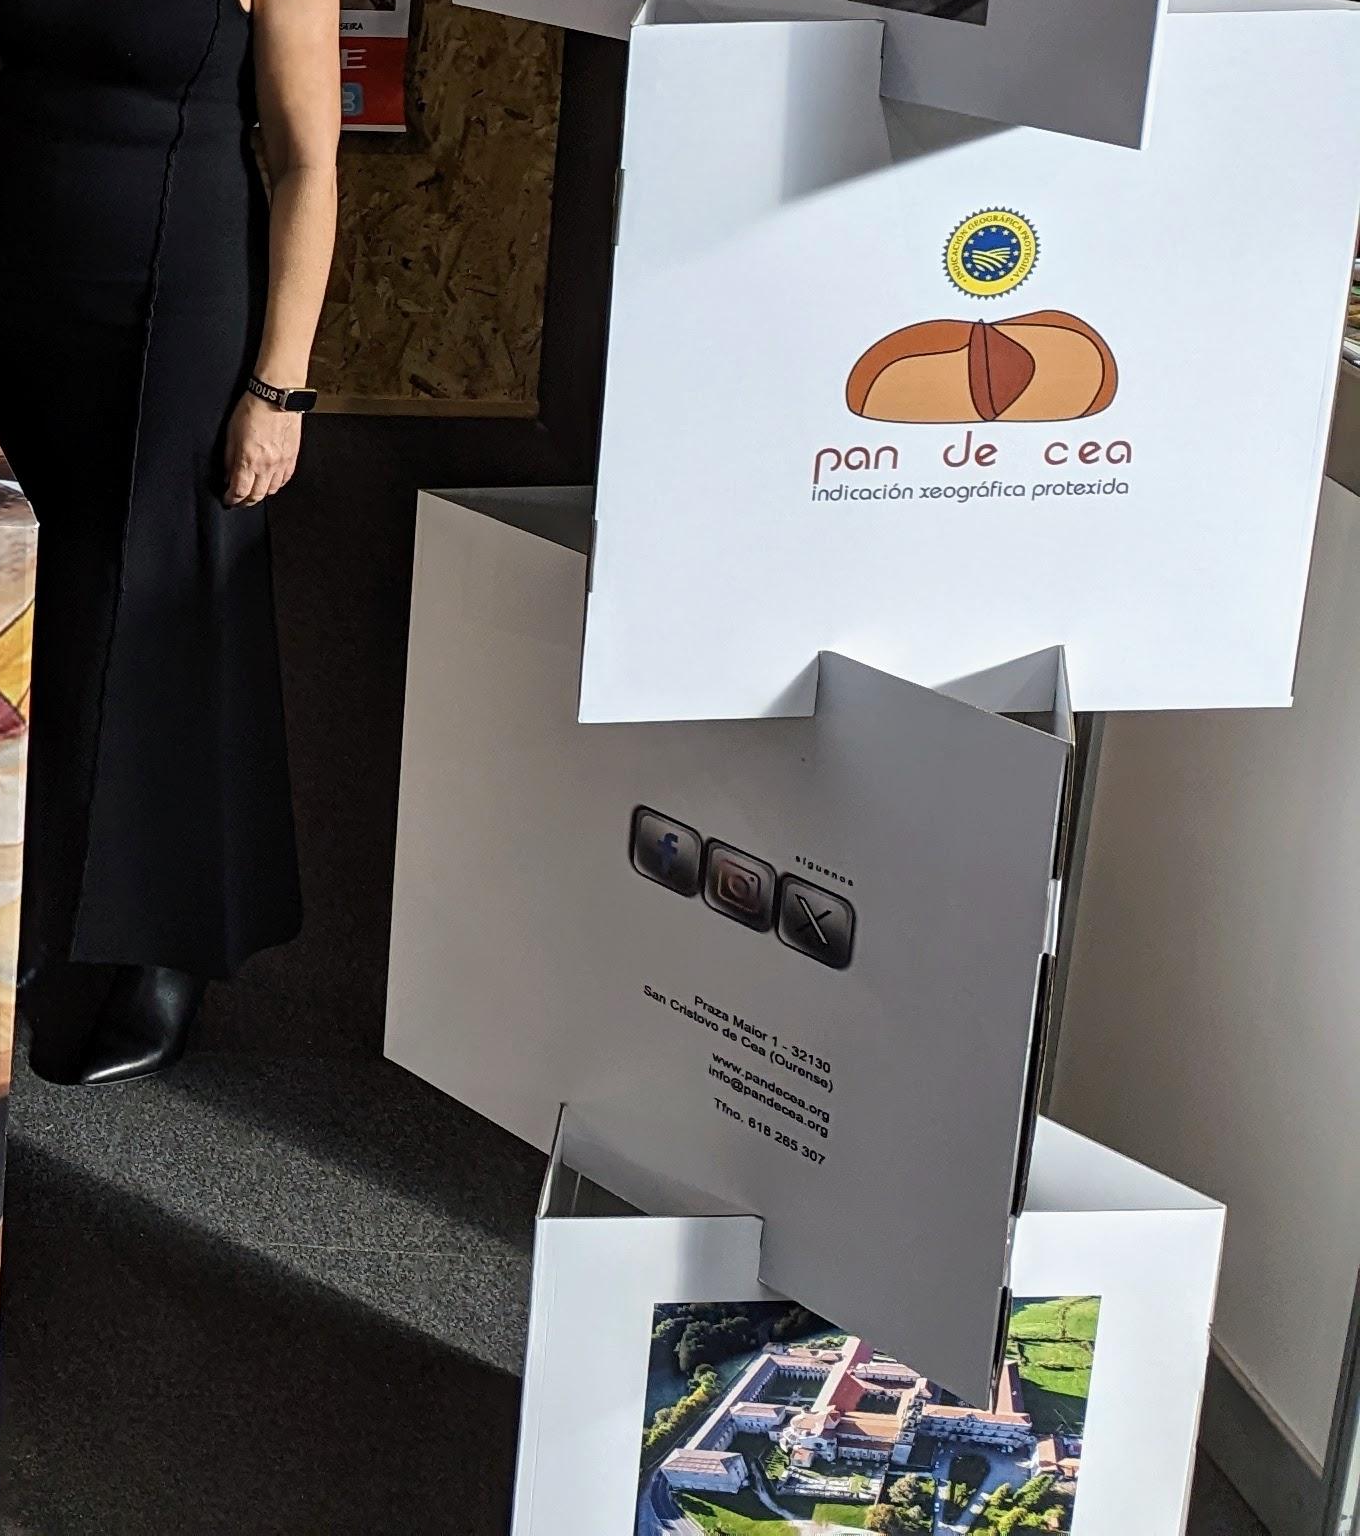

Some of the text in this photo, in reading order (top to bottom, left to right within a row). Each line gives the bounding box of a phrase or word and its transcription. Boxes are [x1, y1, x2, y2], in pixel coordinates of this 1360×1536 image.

[951, 215, 1032, 280] INDICACIÓN GEOGRÁFICA PROTEGIDA
[812, 431, 1131, 484] pan de cea
[812, 479, 1128, 502] indicación xeográfica protexida
[643, 984, 834, 1093] San Cristovo de Cea (Ourense)
[694, 996, 831, 1074] Praza Maior 1 32130
[714, 1097, 826, 1165] Tfno. 618 265 307
